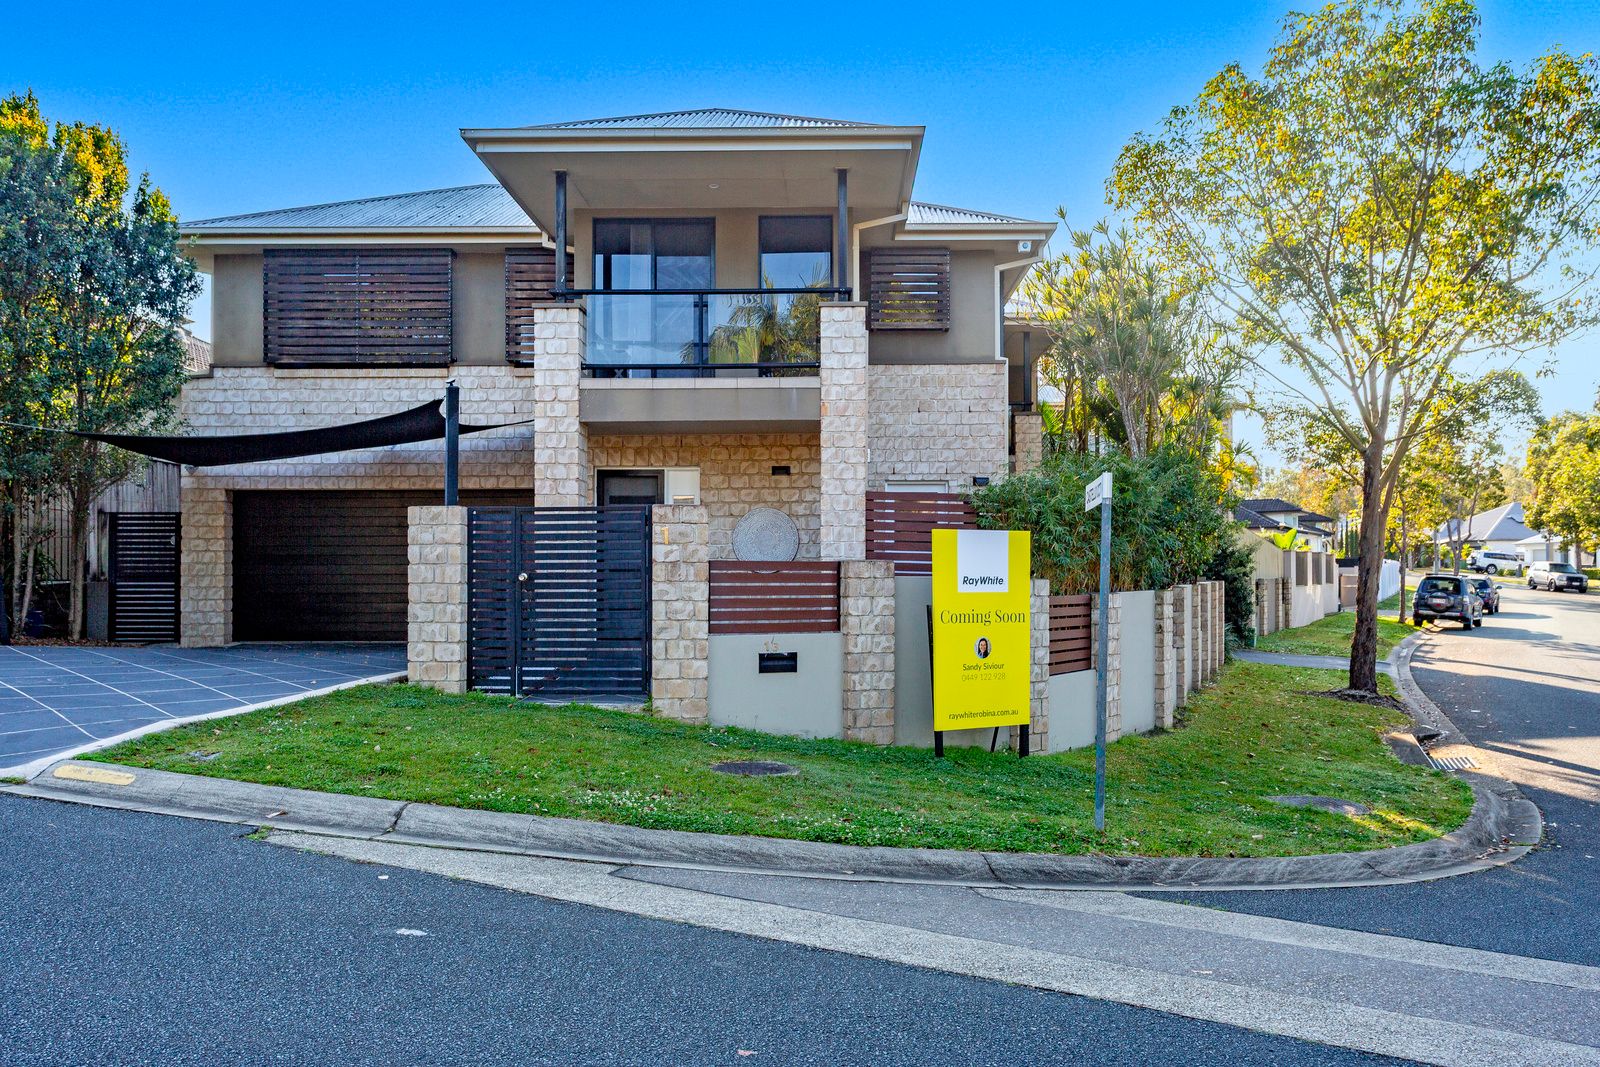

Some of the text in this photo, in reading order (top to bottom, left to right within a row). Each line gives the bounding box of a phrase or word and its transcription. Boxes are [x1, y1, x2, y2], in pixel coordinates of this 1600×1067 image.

[940, 609, 1025, 626] Coming Soon
[962, 663, 982, 671] Sandy
[948, 709, 1019, 720] raywhiterobina.com.au
